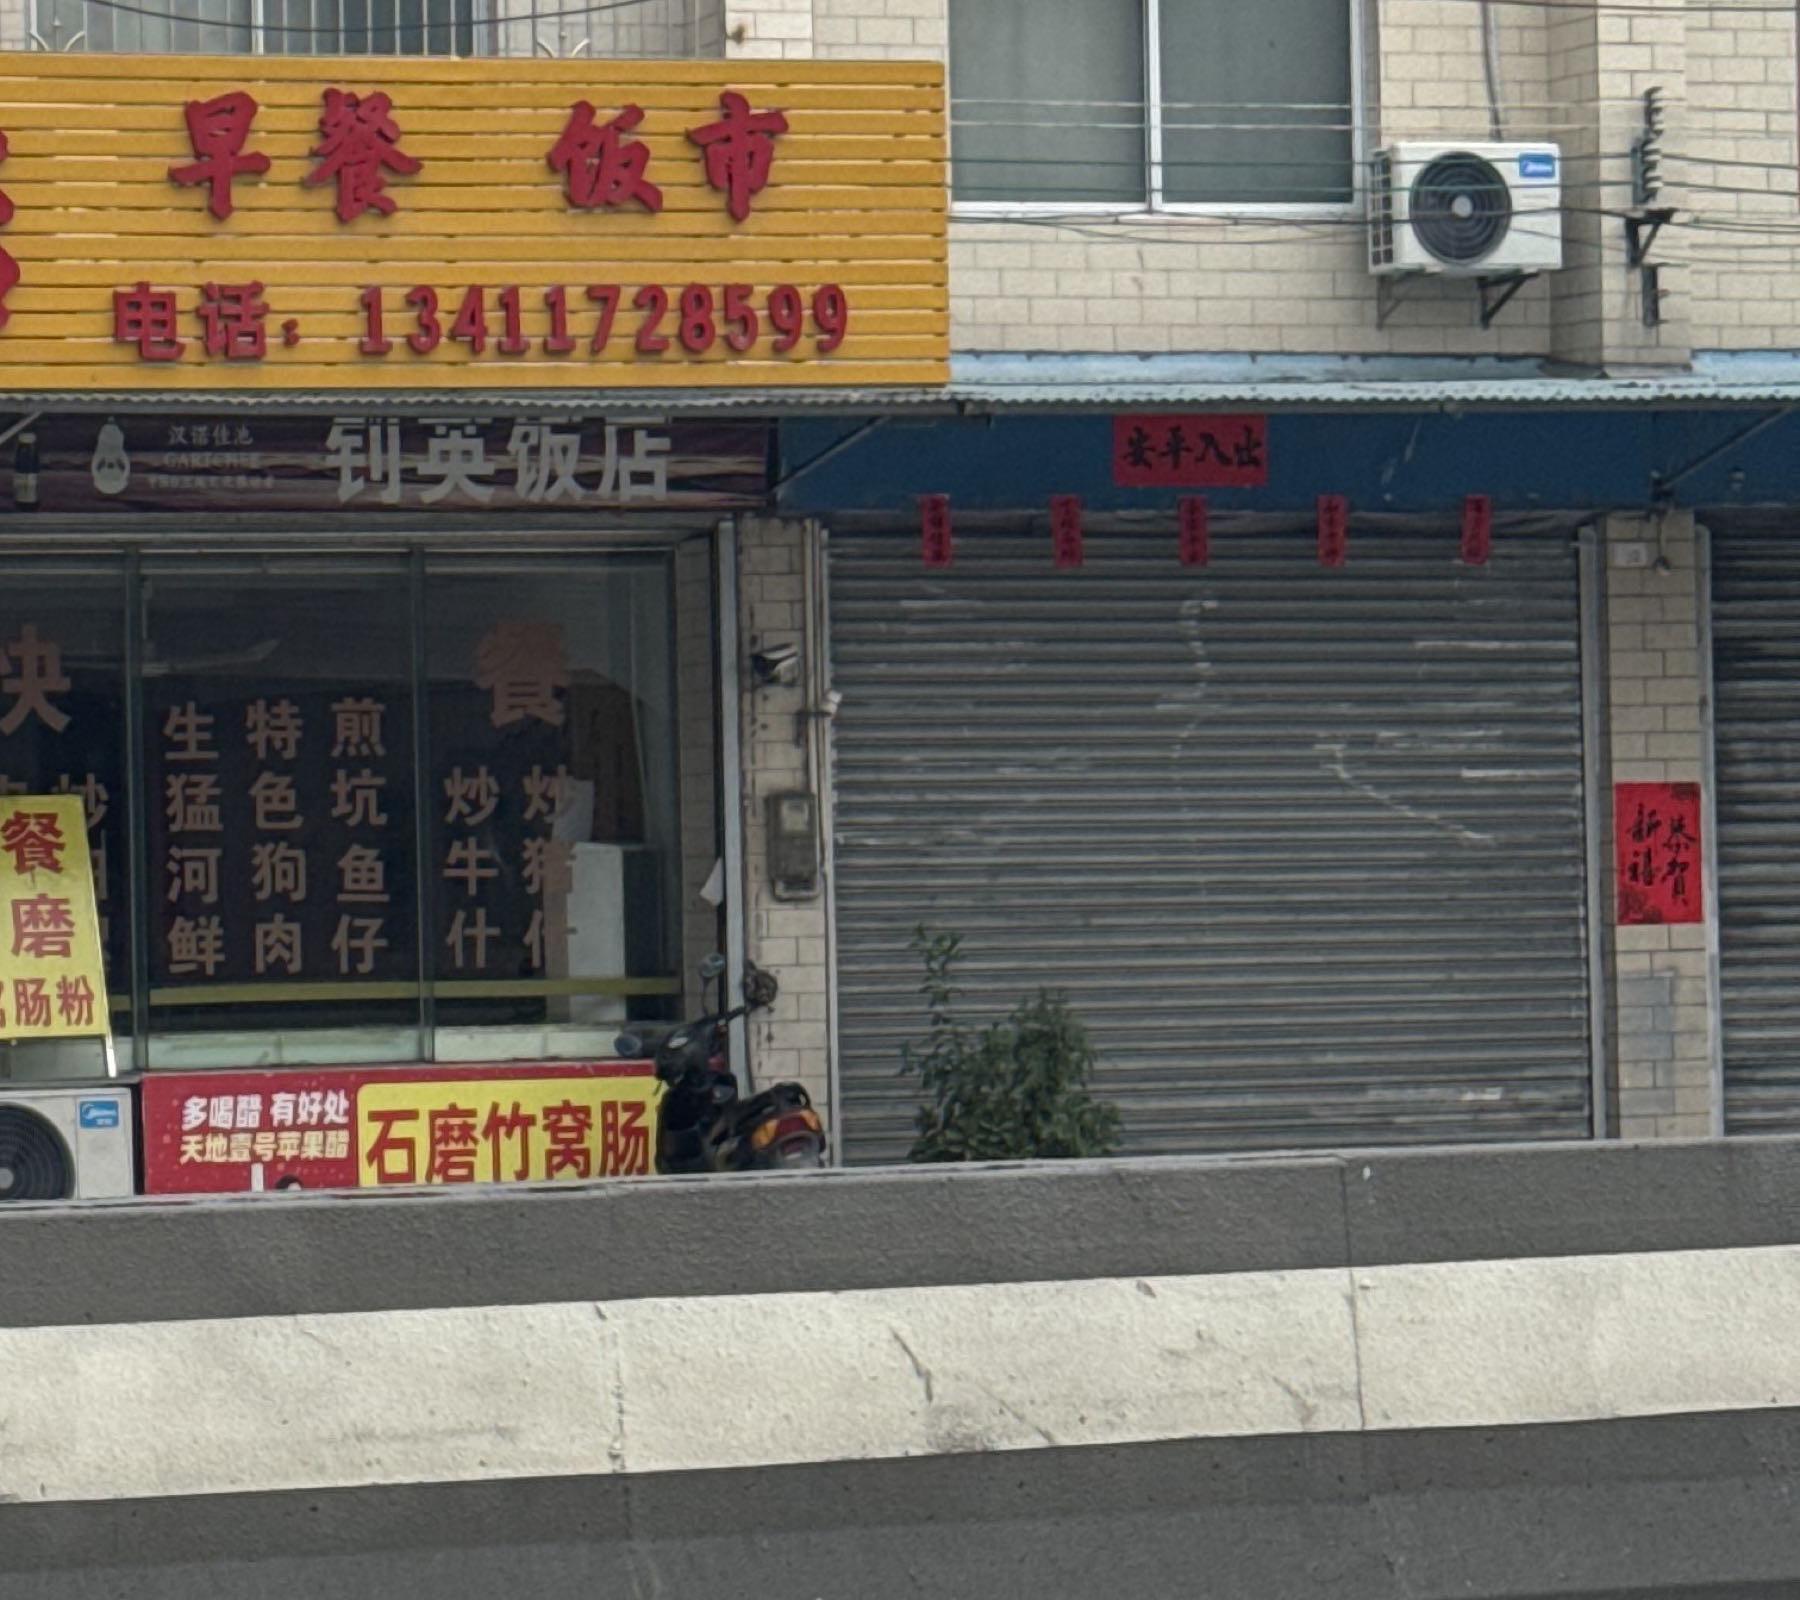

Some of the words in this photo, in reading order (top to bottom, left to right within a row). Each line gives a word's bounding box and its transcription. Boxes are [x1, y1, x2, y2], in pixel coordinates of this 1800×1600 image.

[168, 87, 423, 223] 早餐
[548, 90, 789, 223] 饭市
[325, 416, 672, 505] 钊英饭店
[162, 701, 227, 978] 生猛河鲜
[245, 697, 308, 976] 特色狗肉
[330, 696, 389, 975] 煎坑鱼仔
[442, 765, 501, 970] 炒牛什
[180, 1128, 351, 1165] 天地壹号苹果醋
[181, 1093, 263, 1132] 多喝醋
[269, 1088, 350, 1128] 有好处
